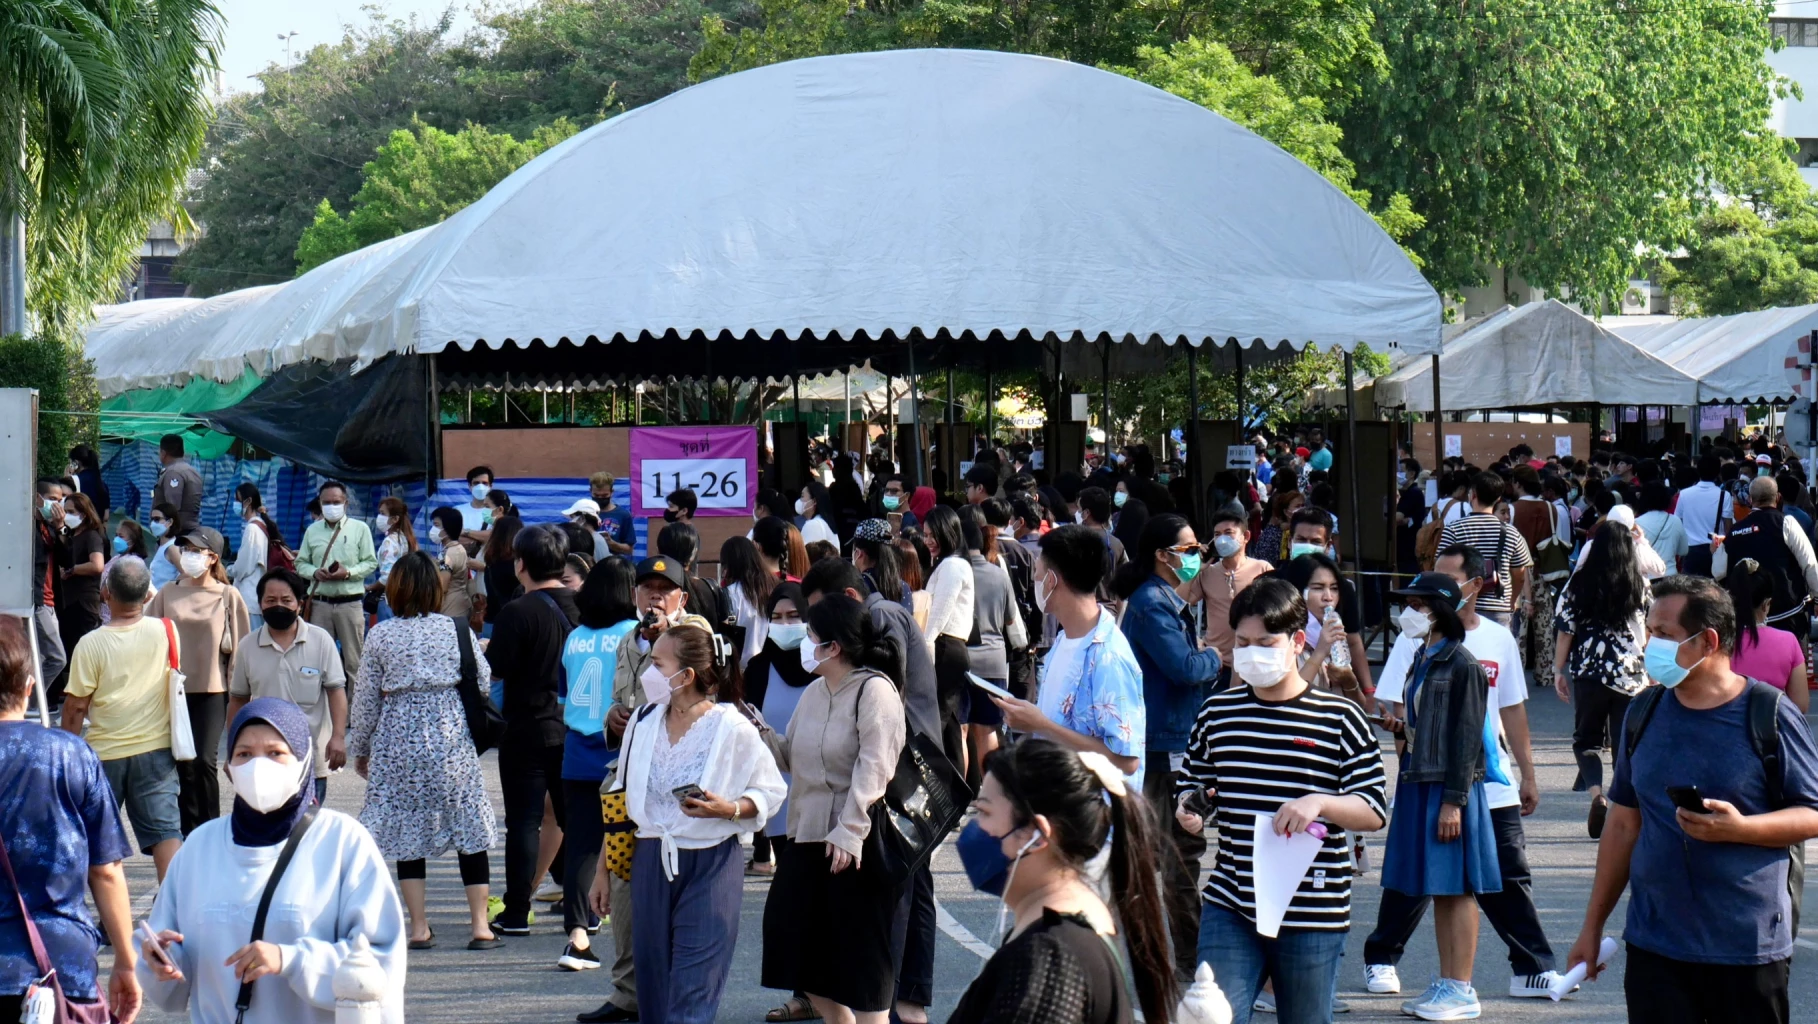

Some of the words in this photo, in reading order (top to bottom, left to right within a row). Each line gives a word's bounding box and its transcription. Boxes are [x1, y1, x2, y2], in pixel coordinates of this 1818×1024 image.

[679, 432, 710, 457] ชุดที่
[652, 470, 739, 498] 11-26
[567, 634, 596, 655] Med
[570, 656, 602, 720] 4
